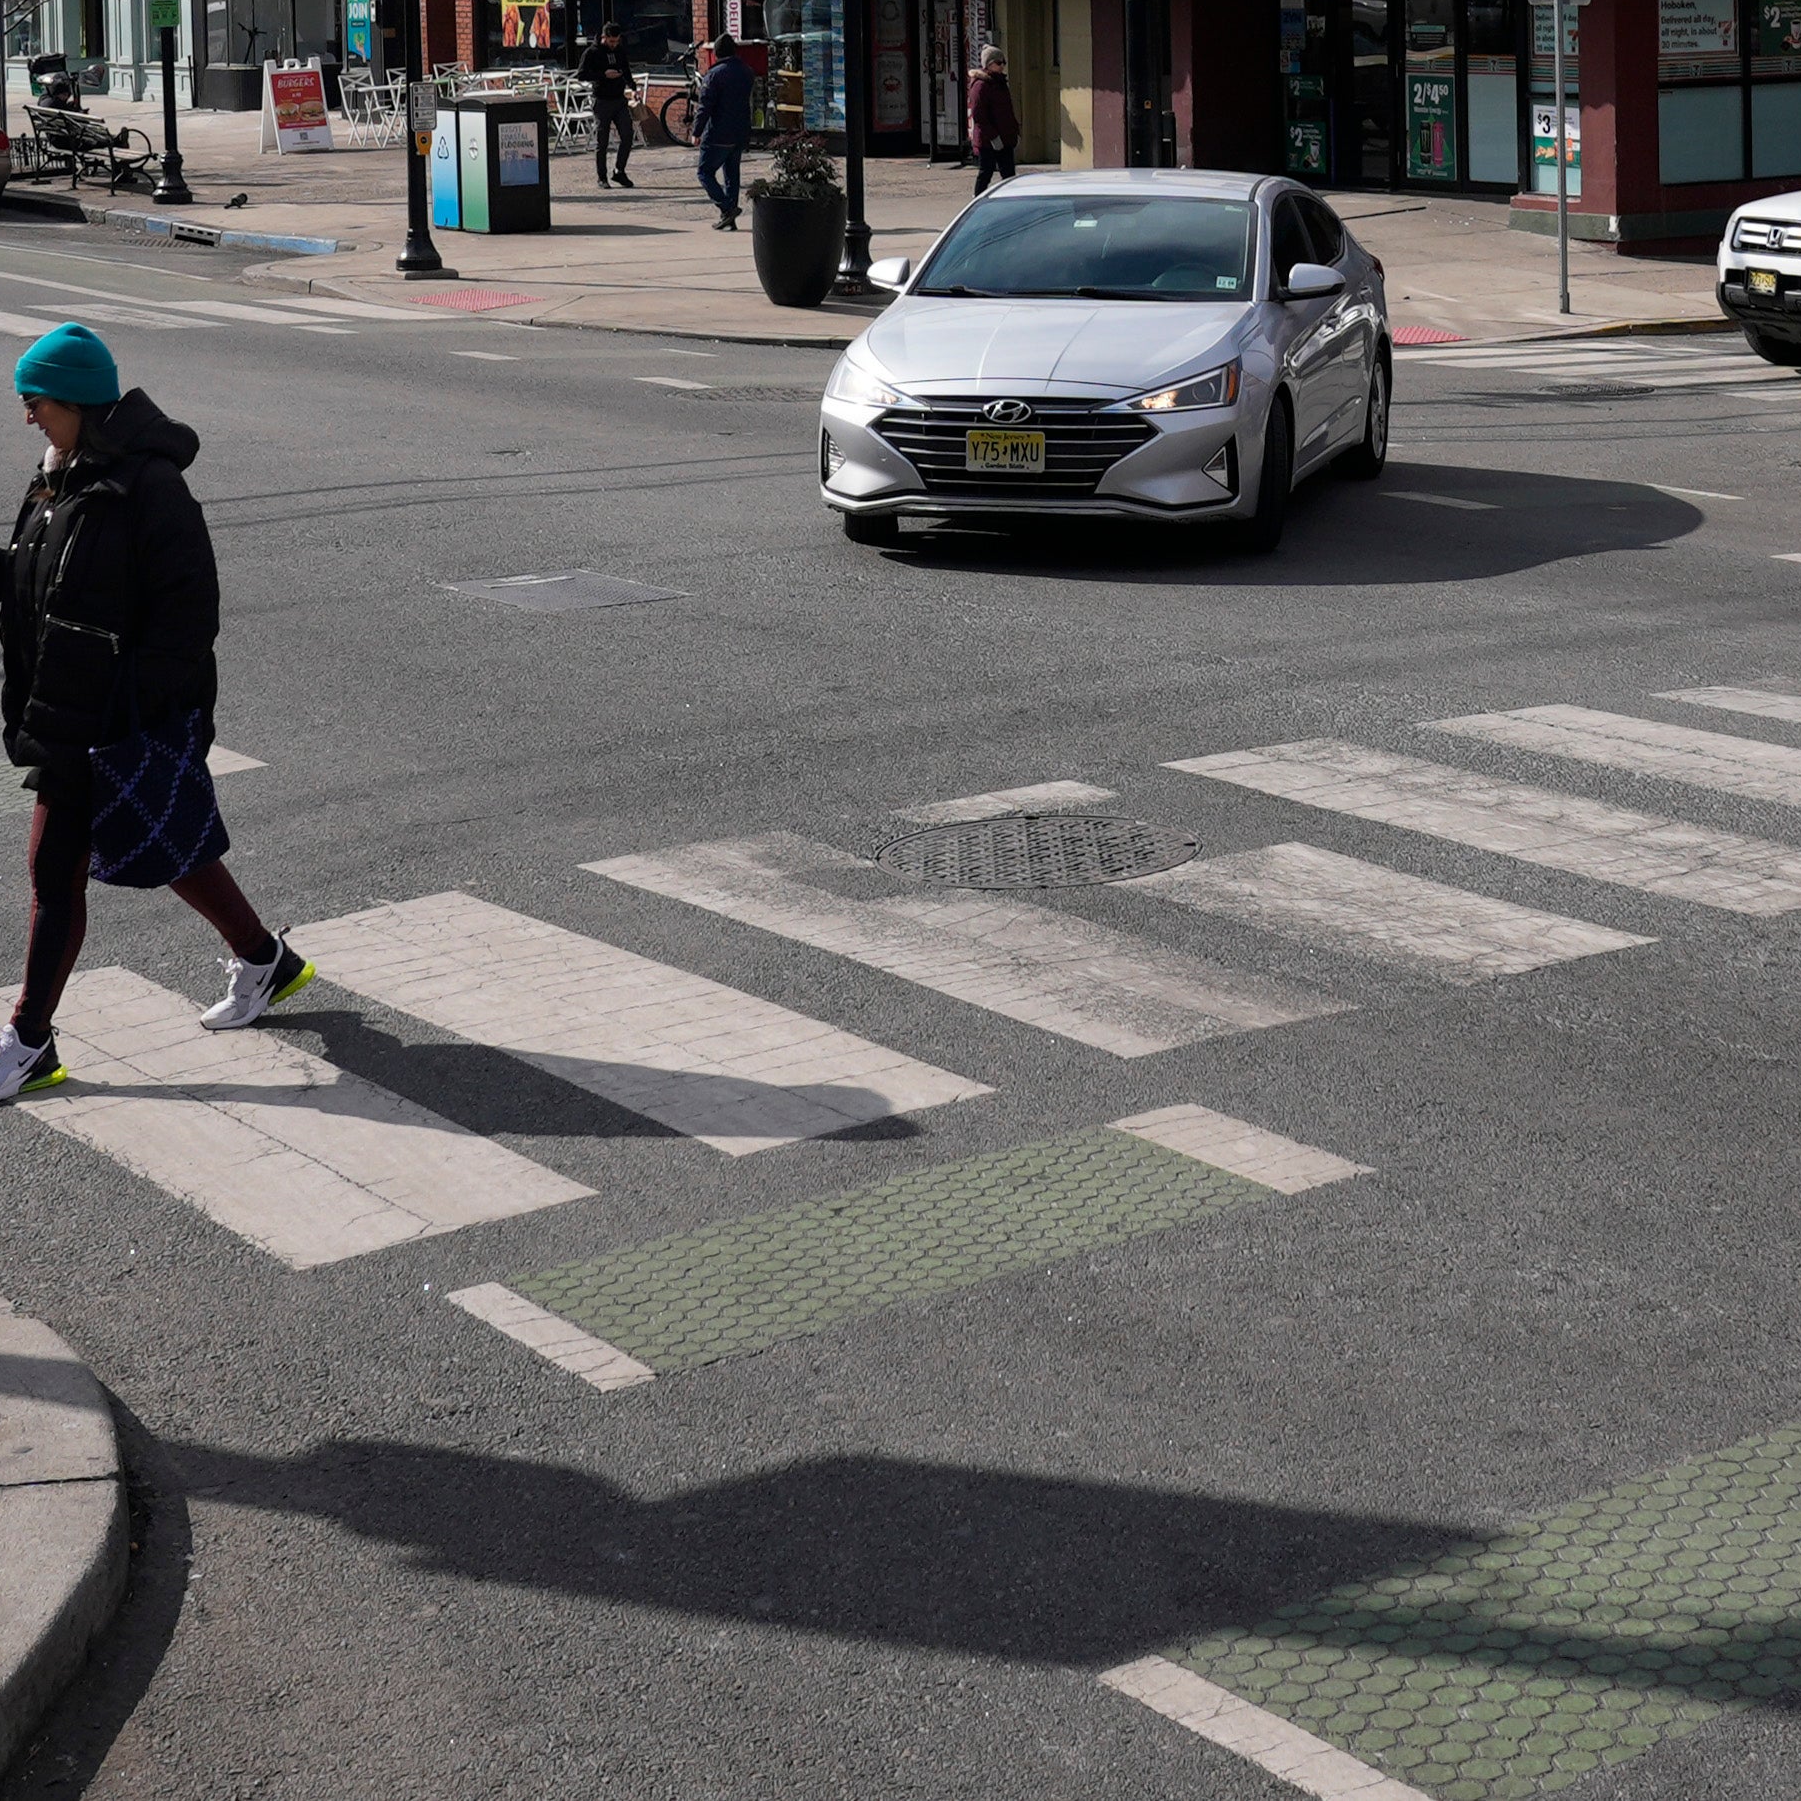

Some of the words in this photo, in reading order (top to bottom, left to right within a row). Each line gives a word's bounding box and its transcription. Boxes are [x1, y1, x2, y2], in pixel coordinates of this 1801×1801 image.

[1660, 0, 1697, 11] Hoboken,
[1763, 5, 1781, 29] $2
[1537, 113, 1551, 134] $3
[972, 441, 1000, 461] Y75
[1010, 441, 1040, 462] MXU
